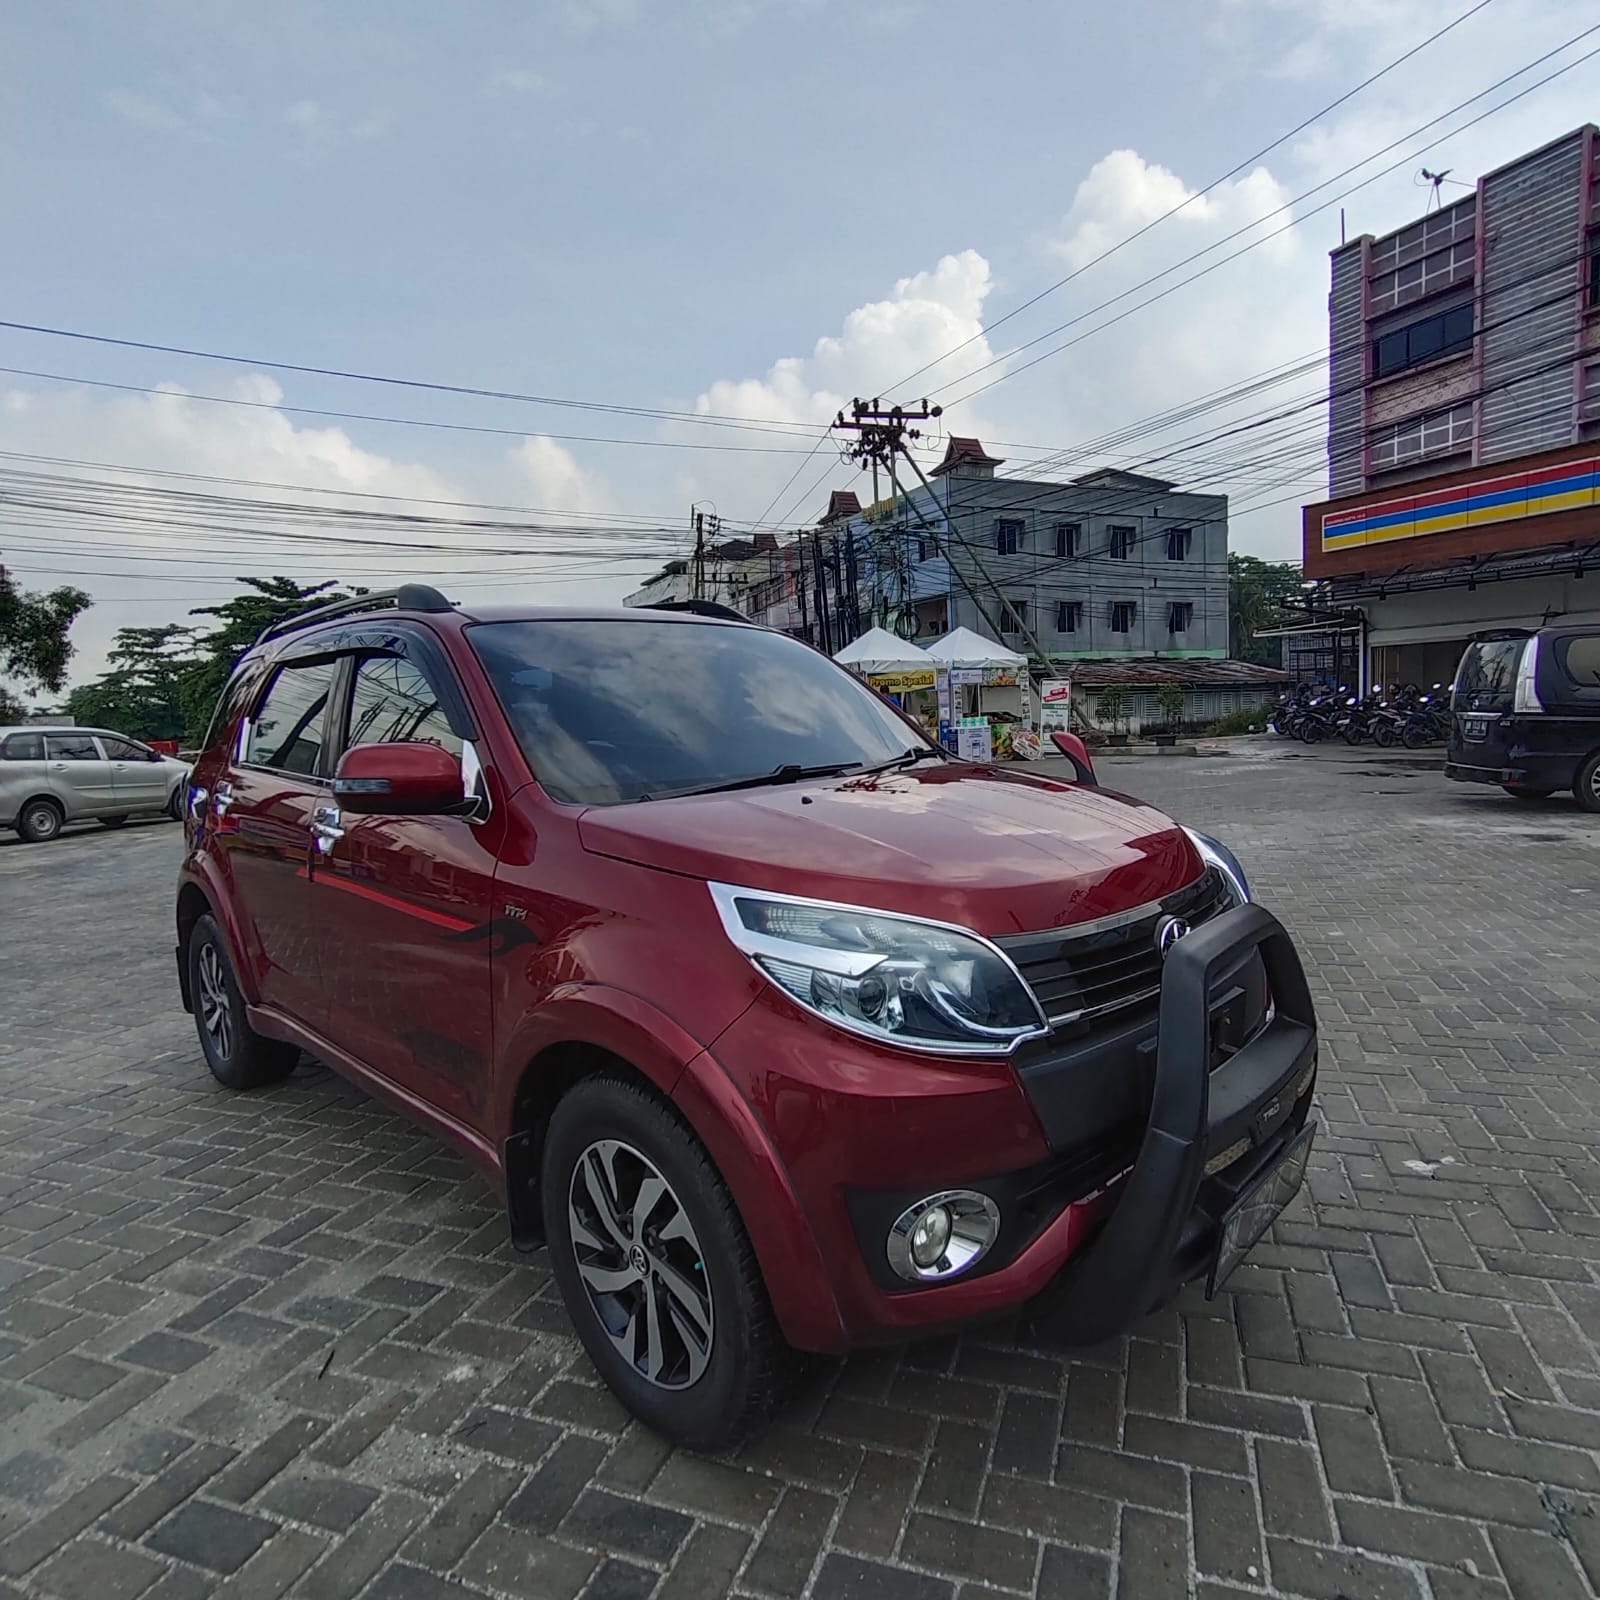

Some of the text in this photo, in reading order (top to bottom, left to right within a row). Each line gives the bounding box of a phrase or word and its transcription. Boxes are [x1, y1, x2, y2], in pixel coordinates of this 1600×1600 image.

[870, 674, 934, 687] Promo Spesial
[1263, 1102, 1280, 1121] TRD
